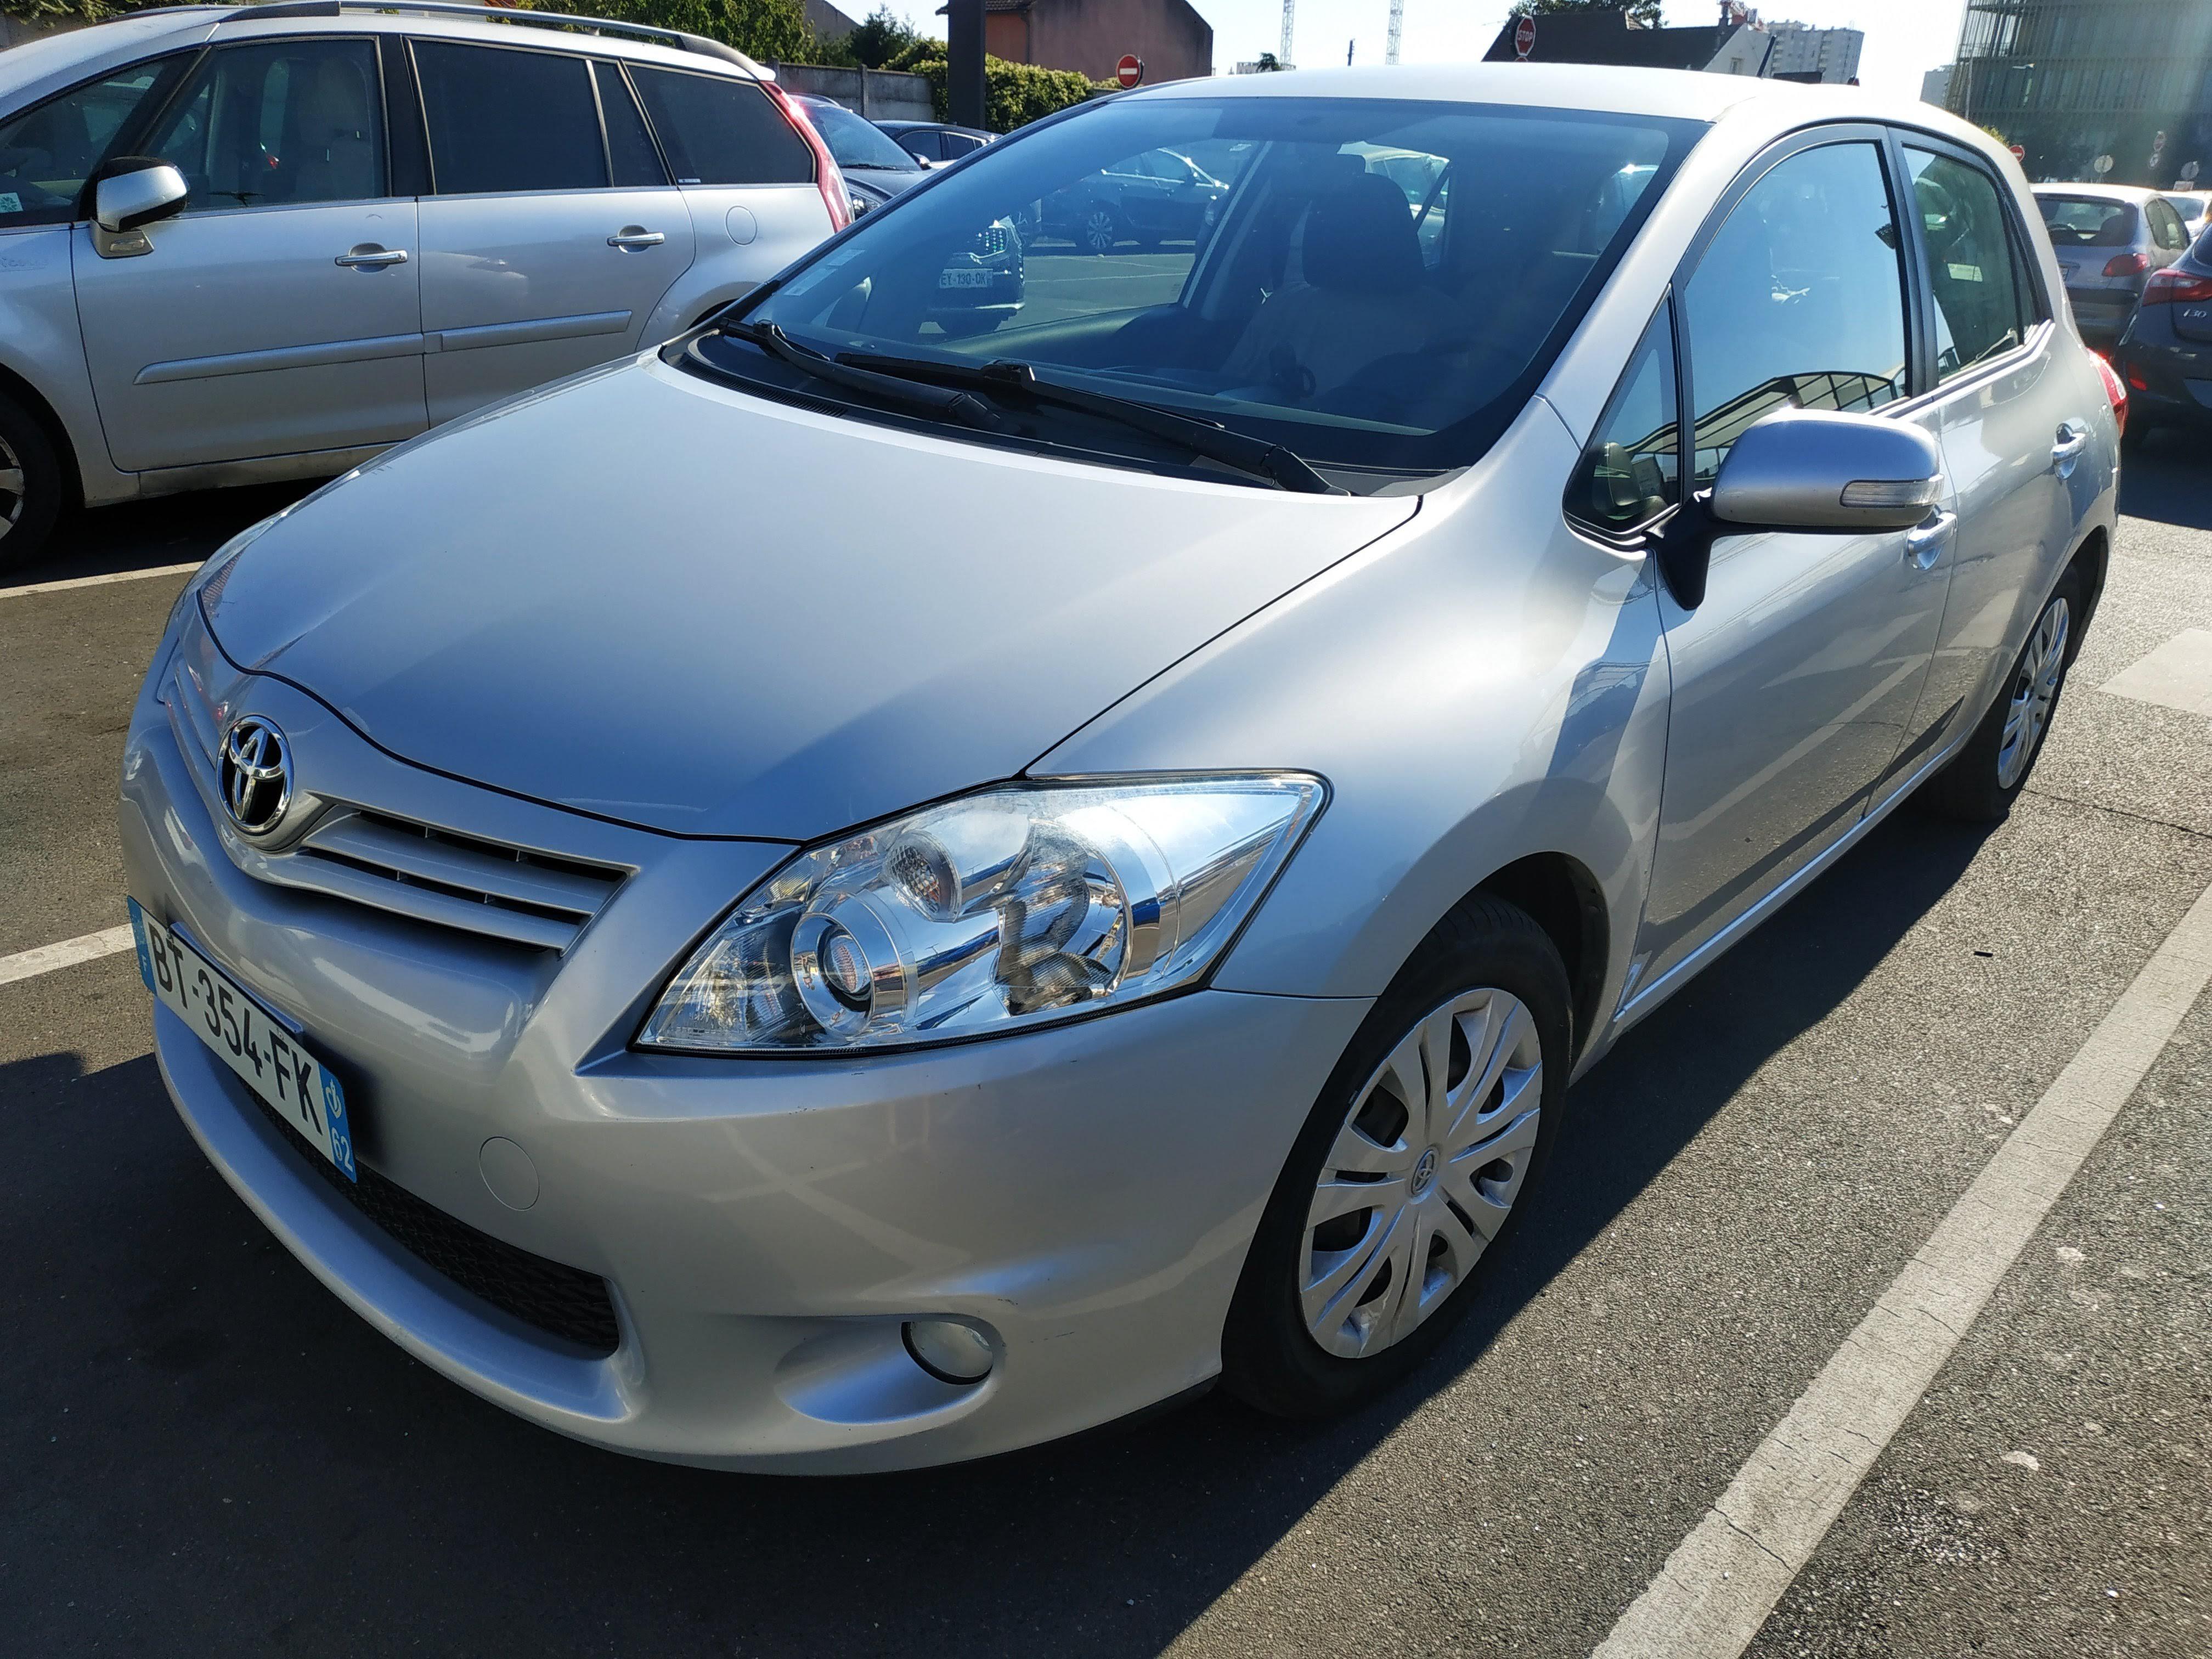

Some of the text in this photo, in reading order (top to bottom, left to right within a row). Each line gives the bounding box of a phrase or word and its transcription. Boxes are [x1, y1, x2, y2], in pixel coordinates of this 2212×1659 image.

[1518, 30, 1533, 42] STOP
[148, 921, 323, 1136] BT-354-FK
[331, 1127, 353, 1172] 62
